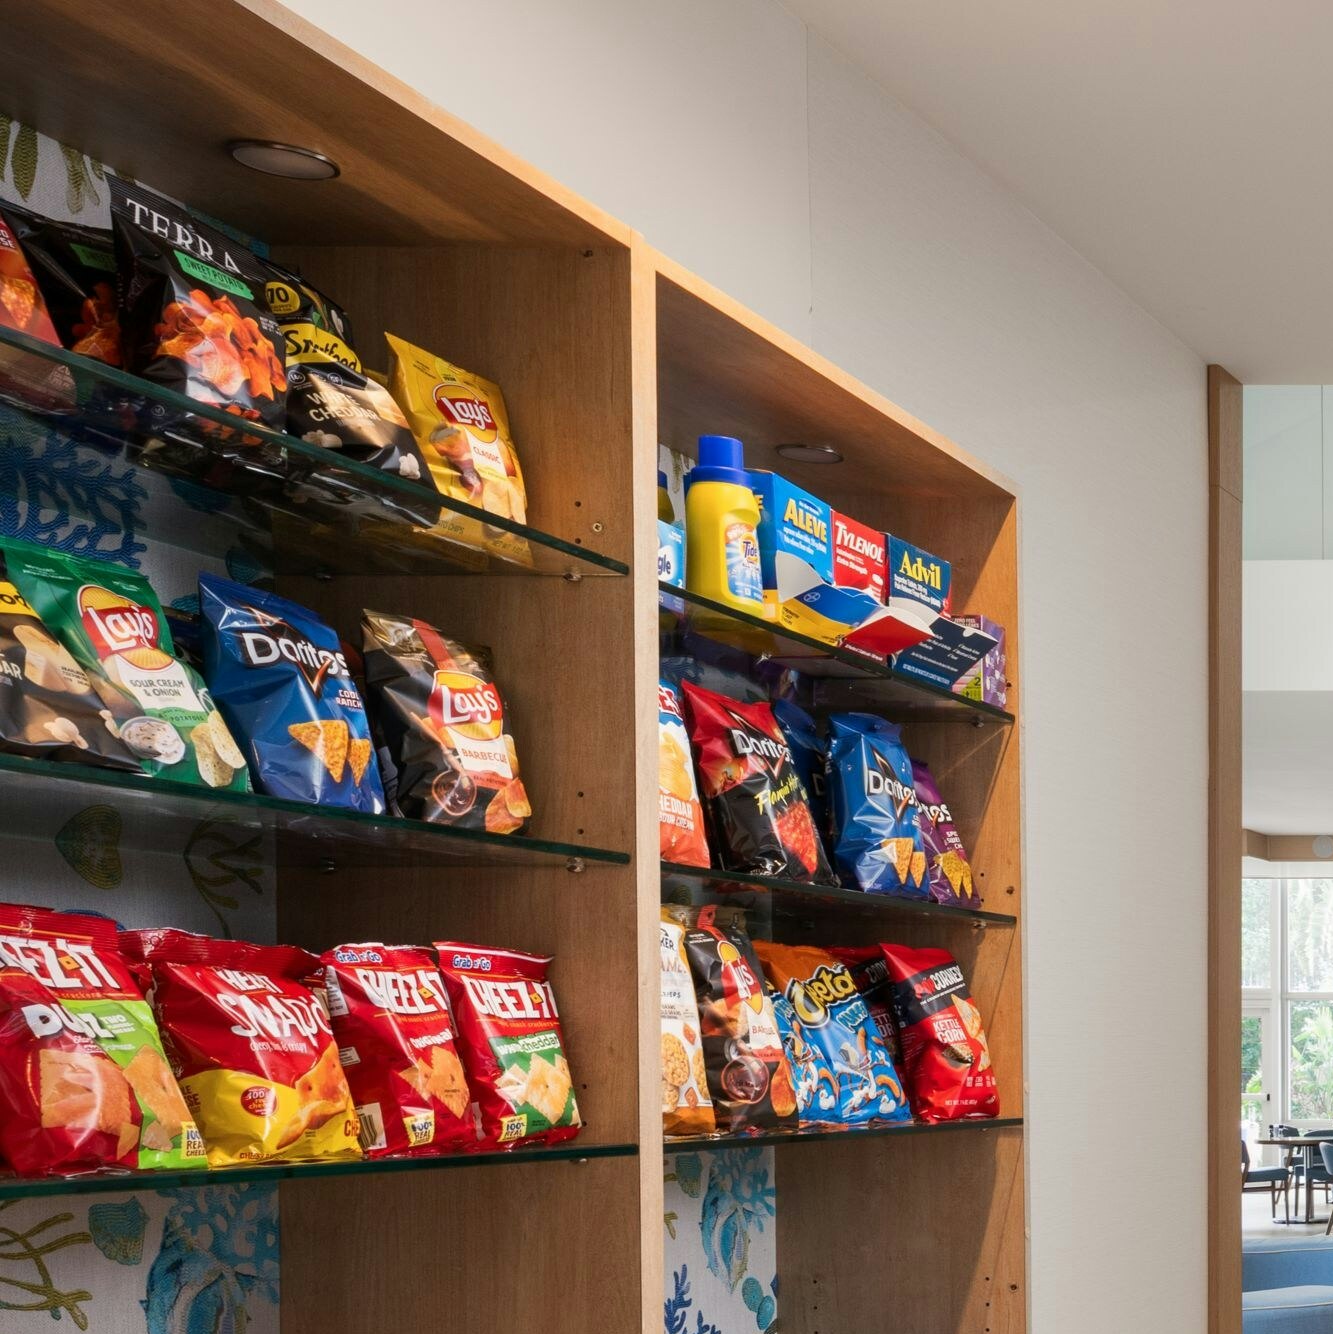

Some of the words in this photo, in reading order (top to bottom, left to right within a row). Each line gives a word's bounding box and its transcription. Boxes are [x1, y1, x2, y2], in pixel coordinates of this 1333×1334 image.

[126, 197, 242, 275] TERRA
[440, 395, 492, 431] Lay's
[783, 497, 829, 544] ALEVE
[743, 540, 758, 559] Tide
[834, 520, 885, 564] TYLENOL
[899, 550, 942, 591] Advil
[86, 605, 155, 650] Lay's
[241, 631, 350, 677] Doritos
[129, 679, 154, 689] SOUR
[156, 679, 185, 689] CREAM
[152, 688, 182, 698] ONION
[337, 688, 360, 700] COOL
[335, 696, 363, 709] RANCH
[440, 684, 500, 725] Lay's
[731, 728, 795, 765] Doritos
[867, 767, 919, 806] Doritos
[335, 950, 359, 963] Grab
[366, 950, 382, 962] Go
[453, 955, 472, 969] Grab
[936, 1028, 965, 1044] CORN
